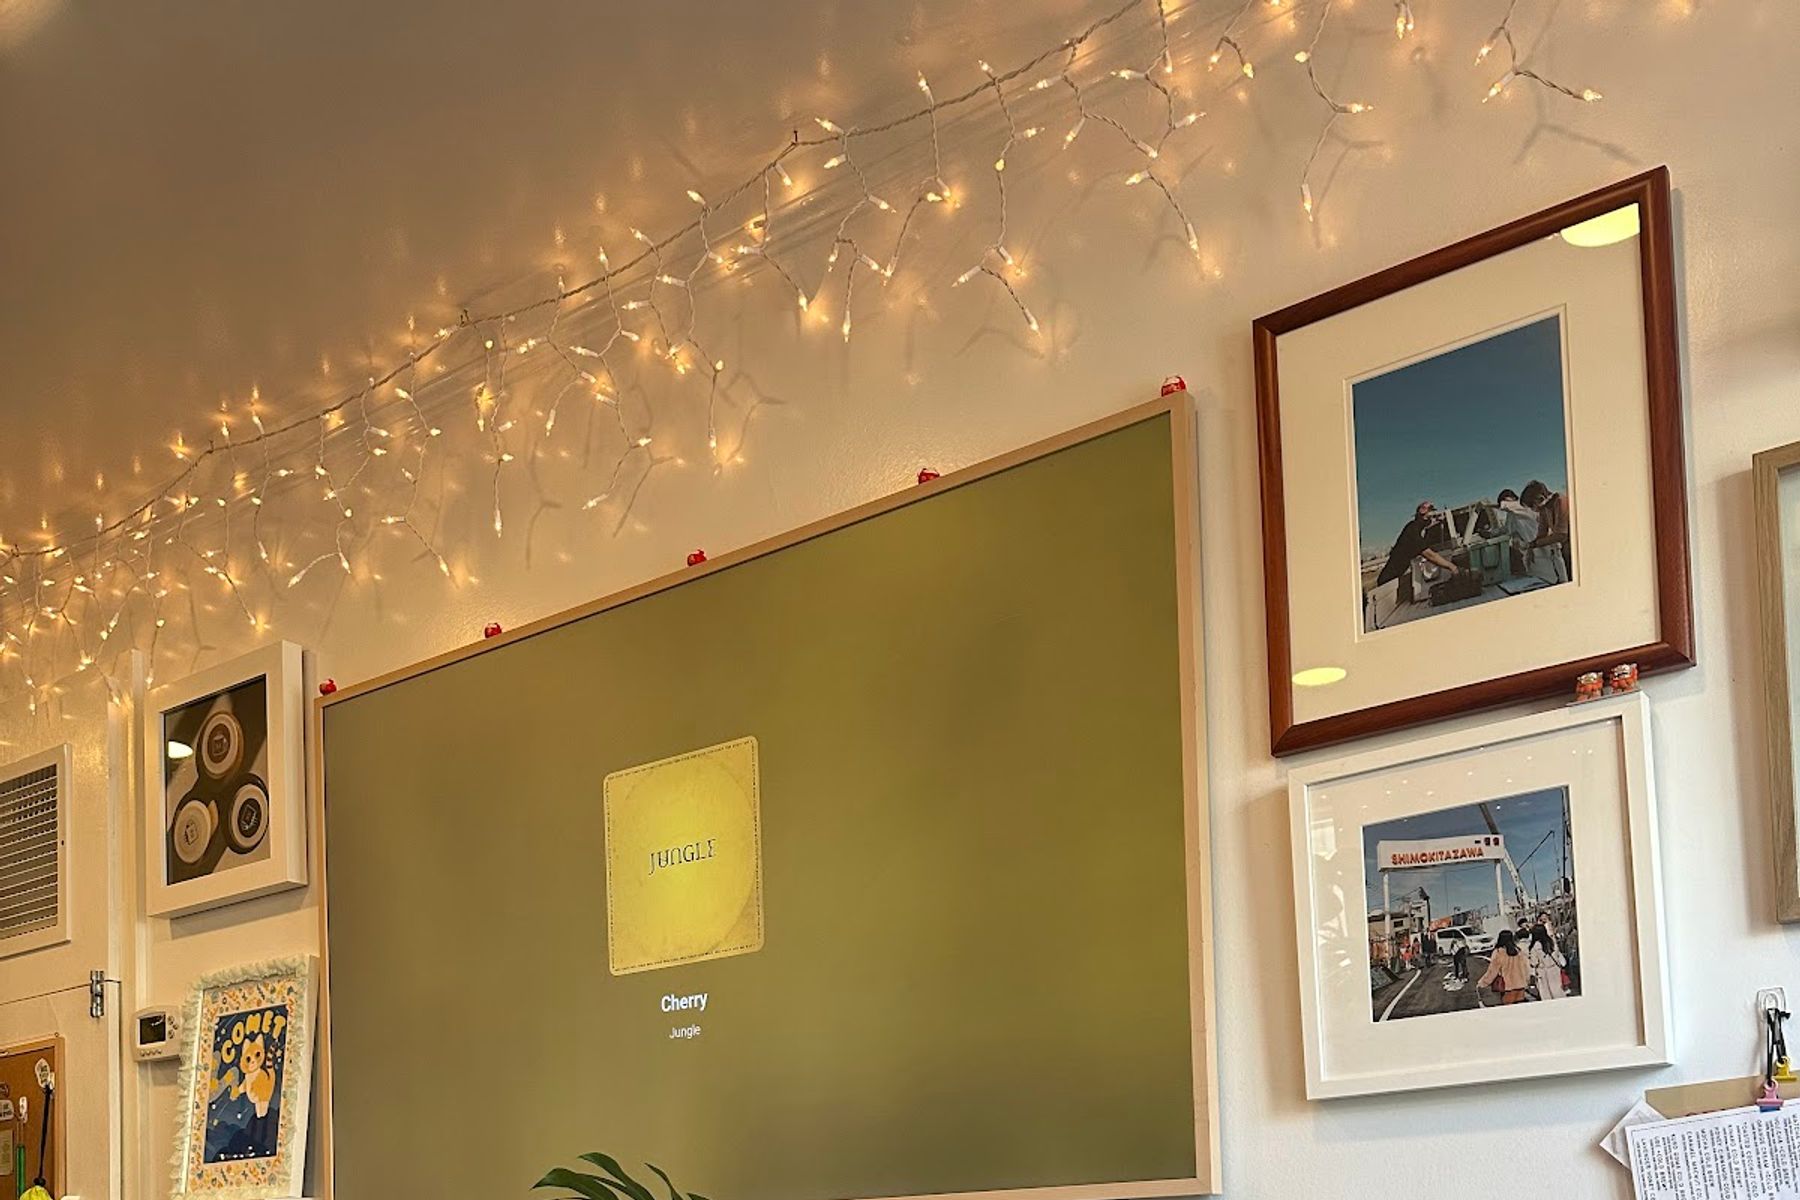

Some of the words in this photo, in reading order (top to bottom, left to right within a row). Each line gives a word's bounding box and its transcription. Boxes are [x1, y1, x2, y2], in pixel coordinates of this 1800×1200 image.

[648, 838, 717, 876] JUNGLE
[1391, 847, 1484, 866] SHIMOKITAZAWA
[661, 991, 708, 1012] Cherry
[221, 1014, 286, 1064] COMET
[669, 1023, 701, 1040] Jungle
